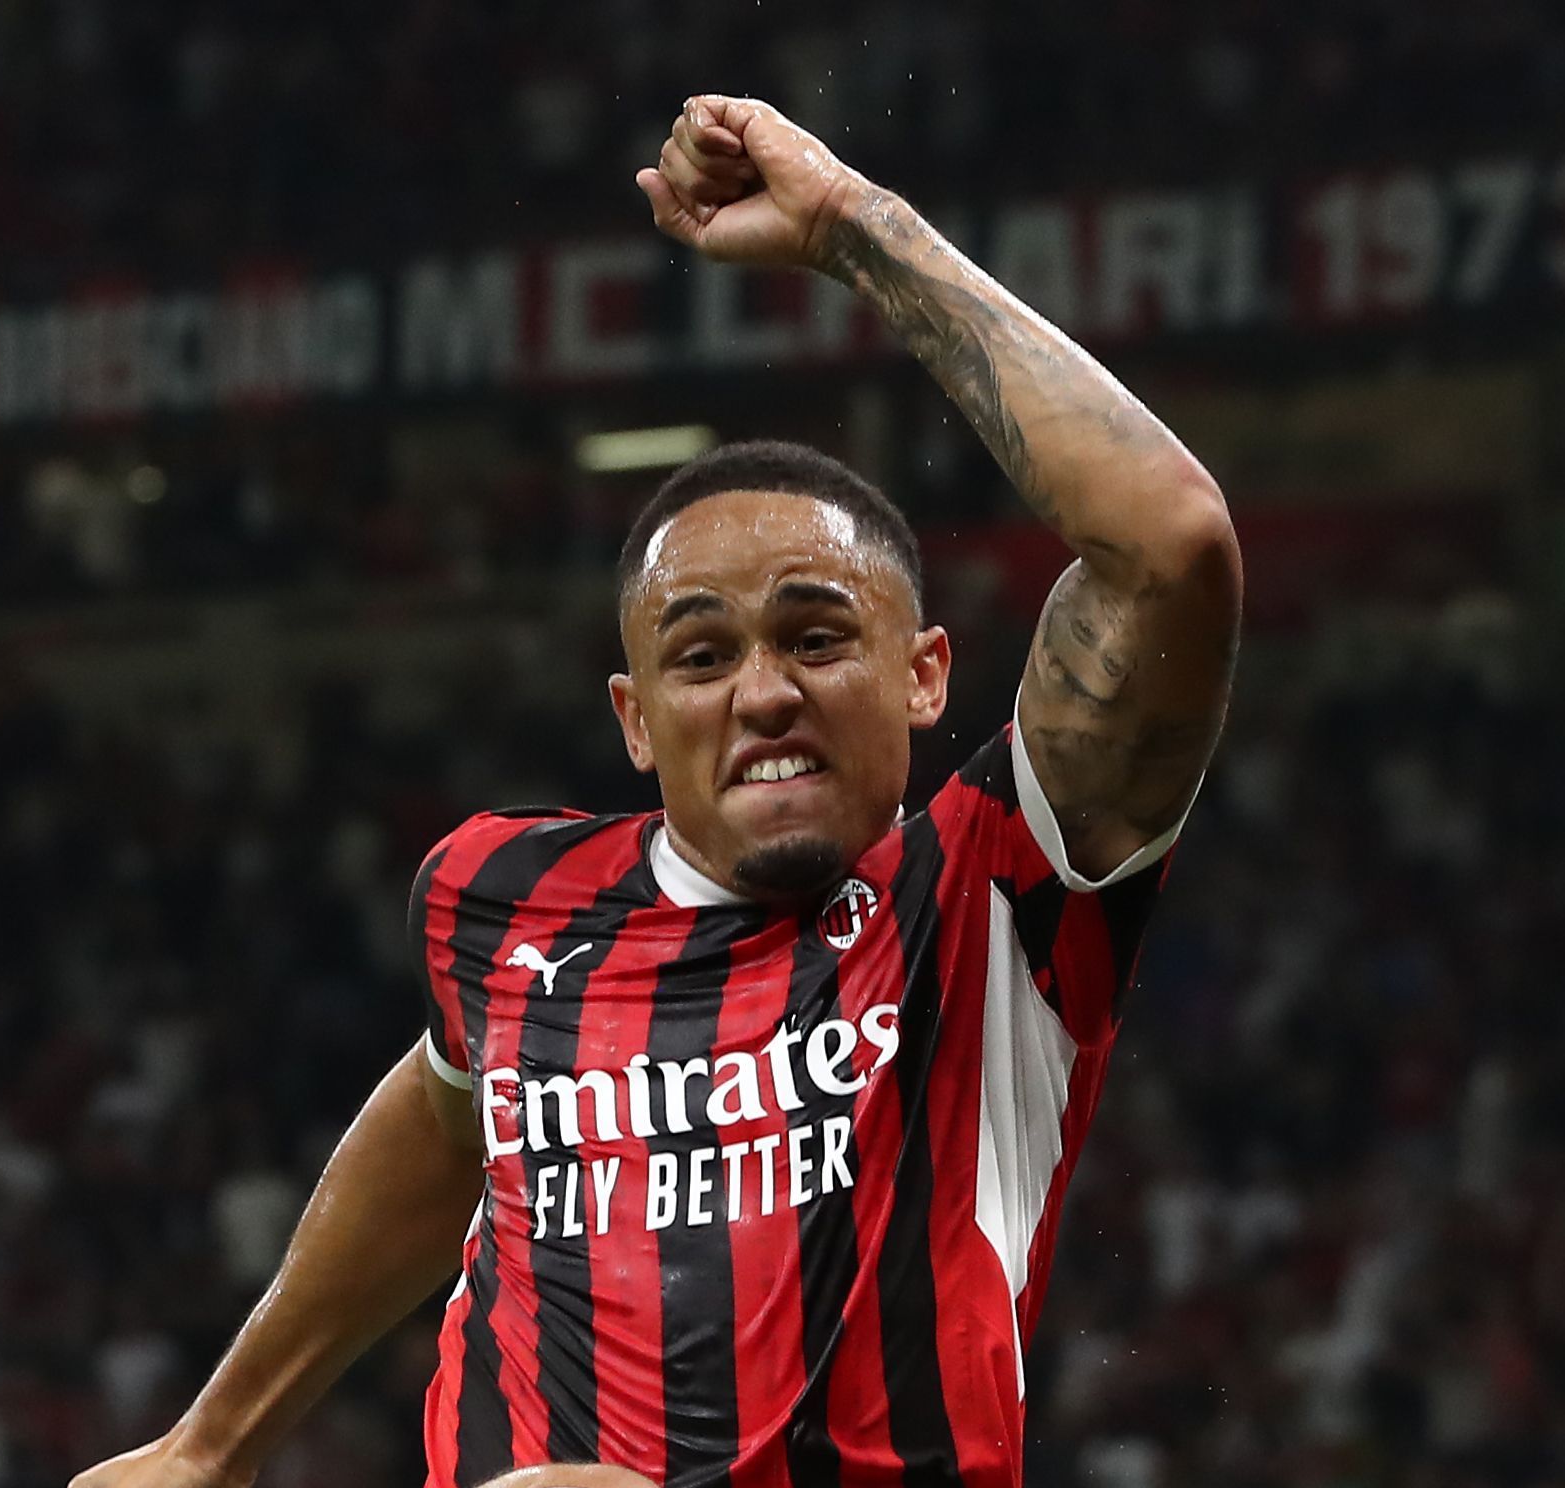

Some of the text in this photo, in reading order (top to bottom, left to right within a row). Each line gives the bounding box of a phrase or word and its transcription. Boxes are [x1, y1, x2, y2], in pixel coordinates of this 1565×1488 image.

[481, 1004, 900, 1165] Emirates
[534, 1115, 854, 1241] FLY BETTER
